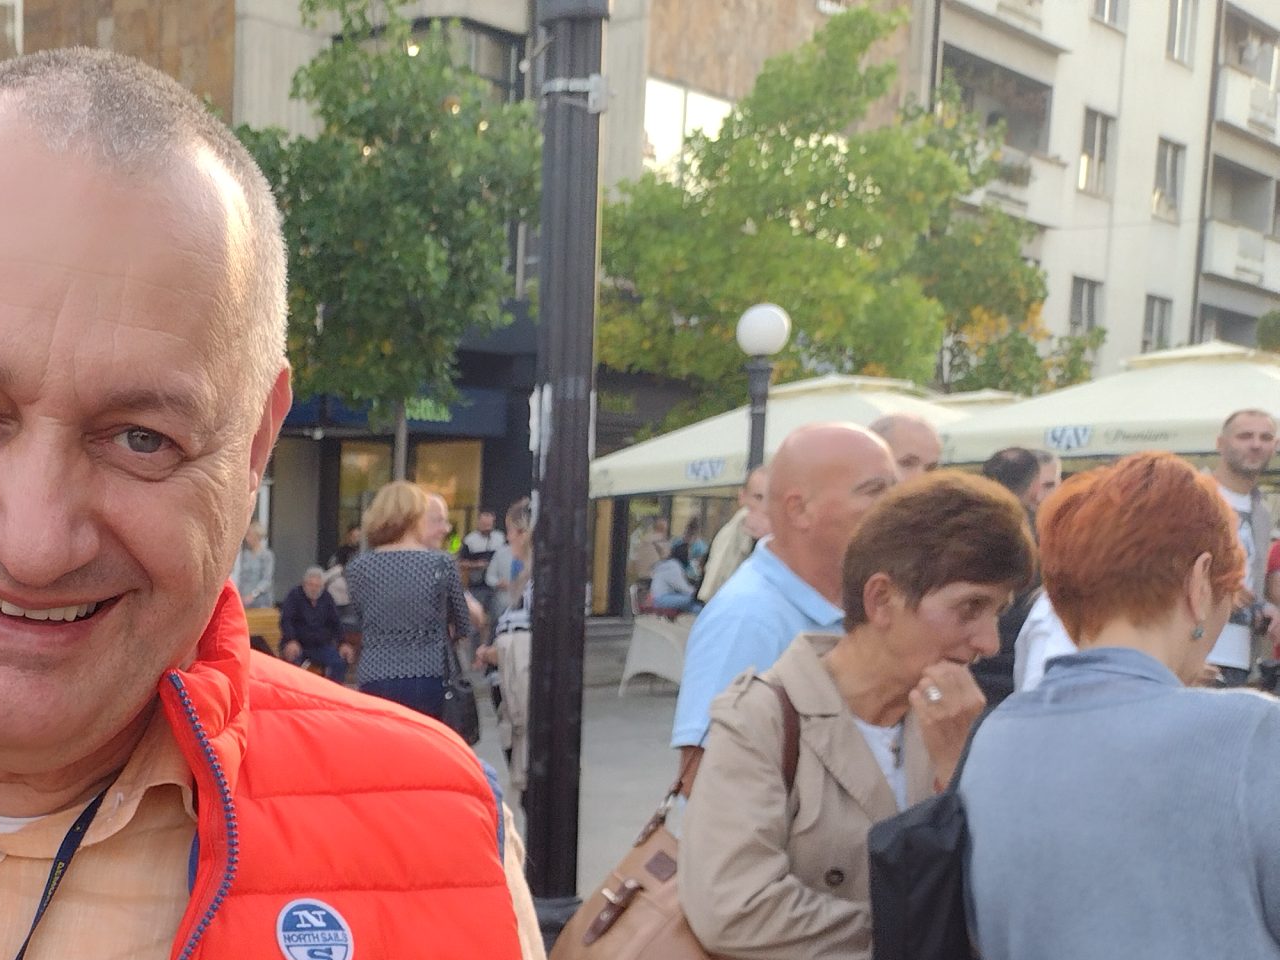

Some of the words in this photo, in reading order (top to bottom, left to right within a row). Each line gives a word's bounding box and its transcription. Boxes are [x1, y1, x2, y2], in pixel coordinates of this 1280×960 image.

[292, 910, 327, 928] N
[282, 932, 320, 944] NORTH
[320, 932, 349, 943] SAILS
